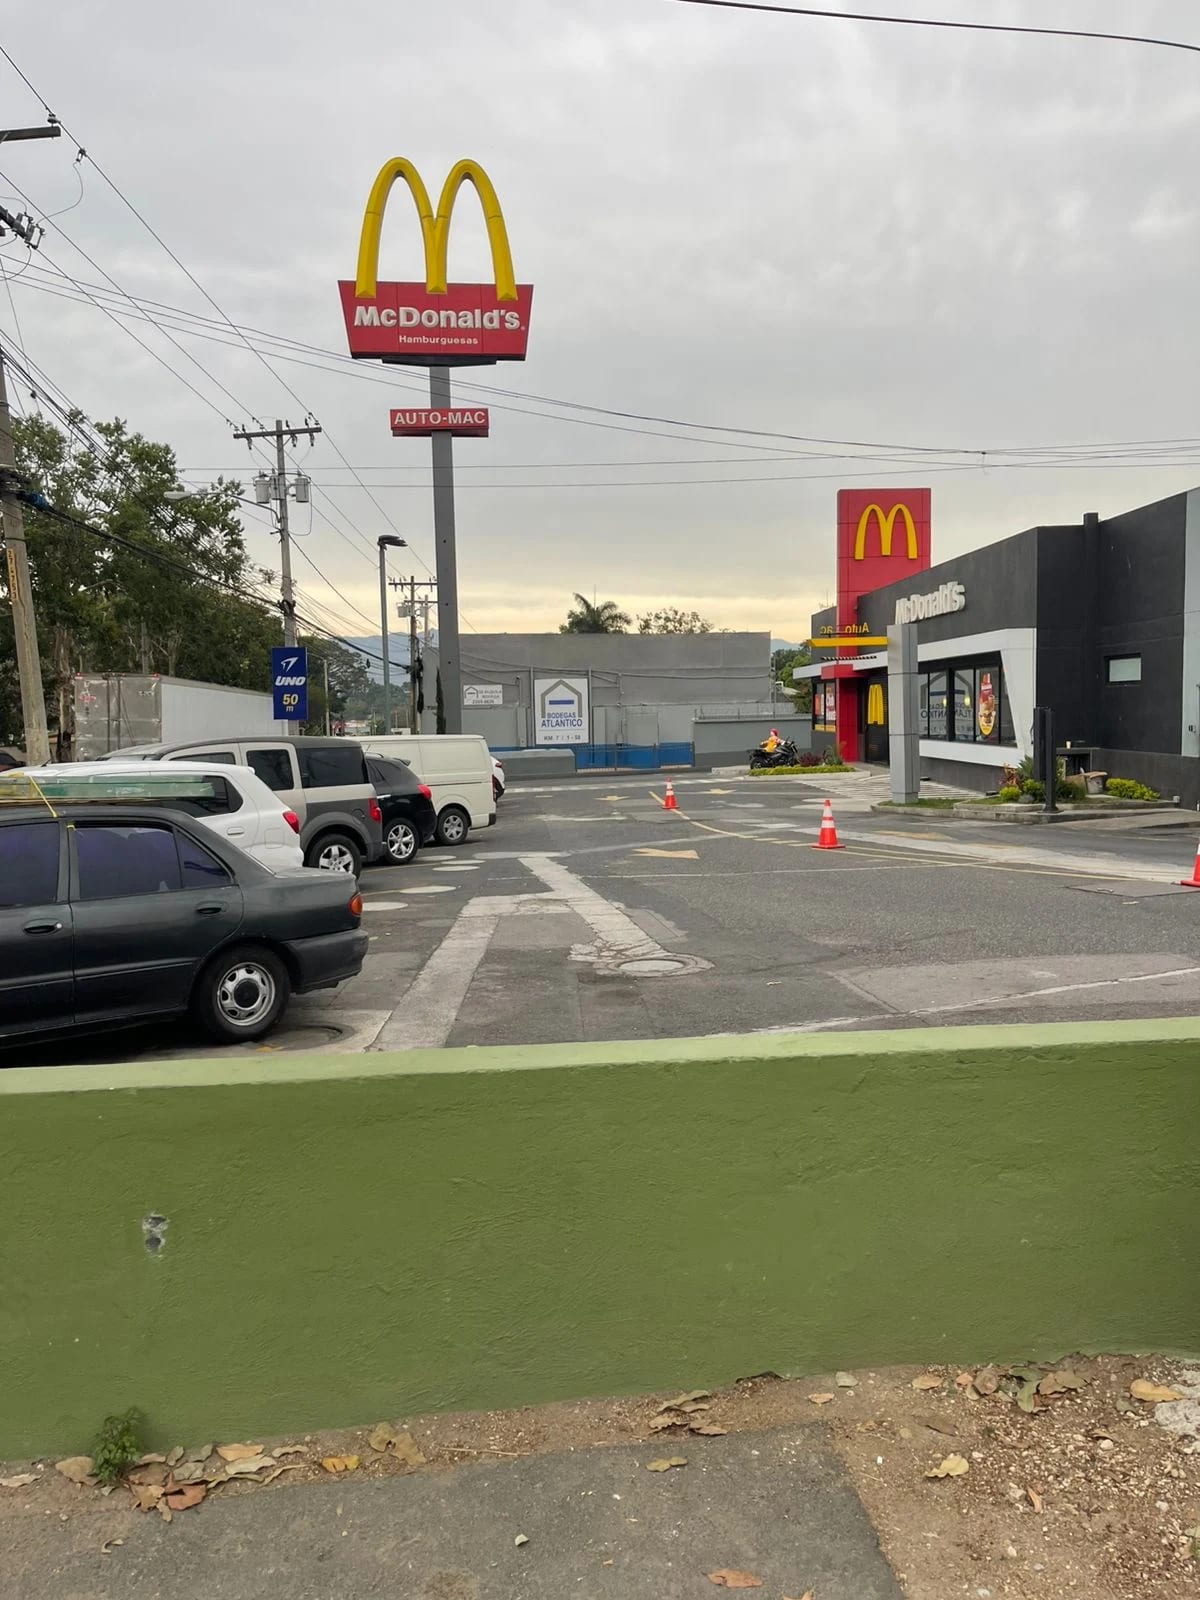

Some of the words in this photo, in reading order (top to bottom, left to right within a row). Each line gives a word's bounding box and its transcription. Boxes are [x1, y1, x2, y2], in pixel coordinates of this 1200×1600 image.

[354, 306, 520, 330] McDonald's
[399, 335, 479, 345] Hamburguesas
[394, 411, 486, 425] AUTO-MAC
[895, 581, 966, 625] McDonald's
[275, 675, 306, 686] UNO
[282, 694, 299, 705] 50
[541, 718, 583, 728] ATLANTICO
